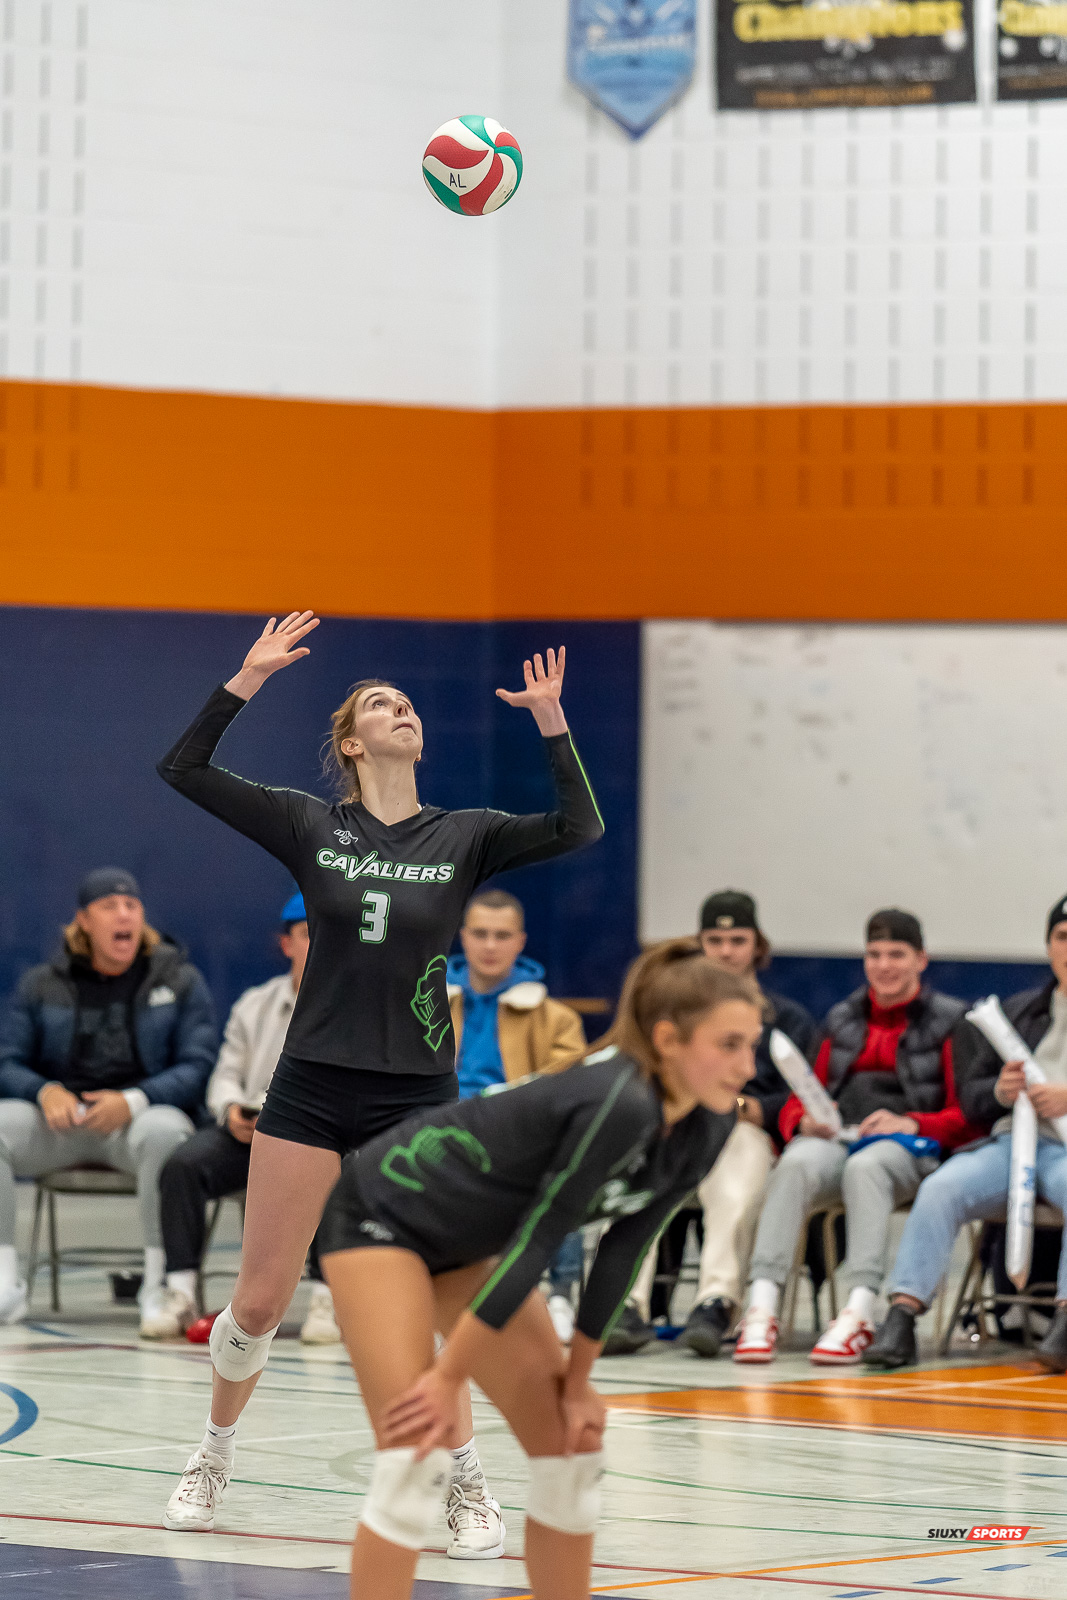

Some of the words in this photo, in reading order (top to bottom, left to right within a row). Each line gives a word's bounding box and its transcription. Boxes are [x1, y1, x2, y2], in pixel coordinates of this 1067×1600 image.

[449, 172, 467, 188] AL
[317, 848, 454, 883] CAVALIERS
[359, 890, 391, 944] 3
